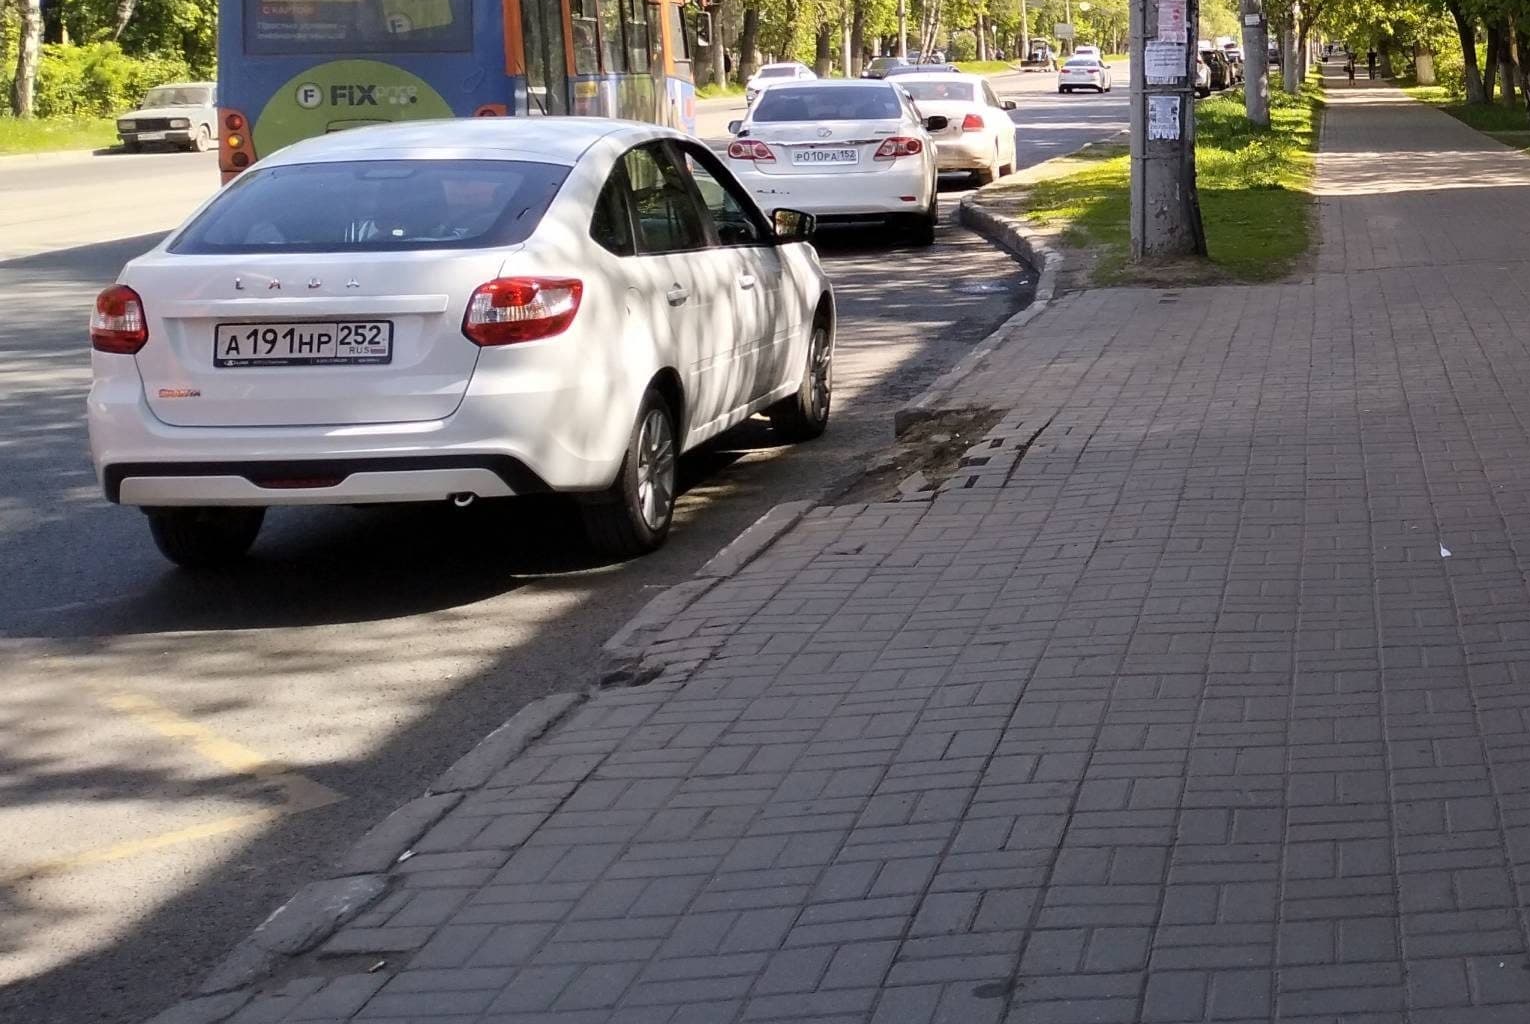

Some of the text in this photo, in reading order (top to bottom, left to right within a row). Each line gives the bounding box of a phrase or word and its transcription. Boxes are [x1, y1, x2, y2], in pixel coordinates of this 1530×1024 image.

[235, 277, 360, 290] LADA
[225, 325, 382, 355] А191НР 252
[349, 346, 370, 354] RUS
